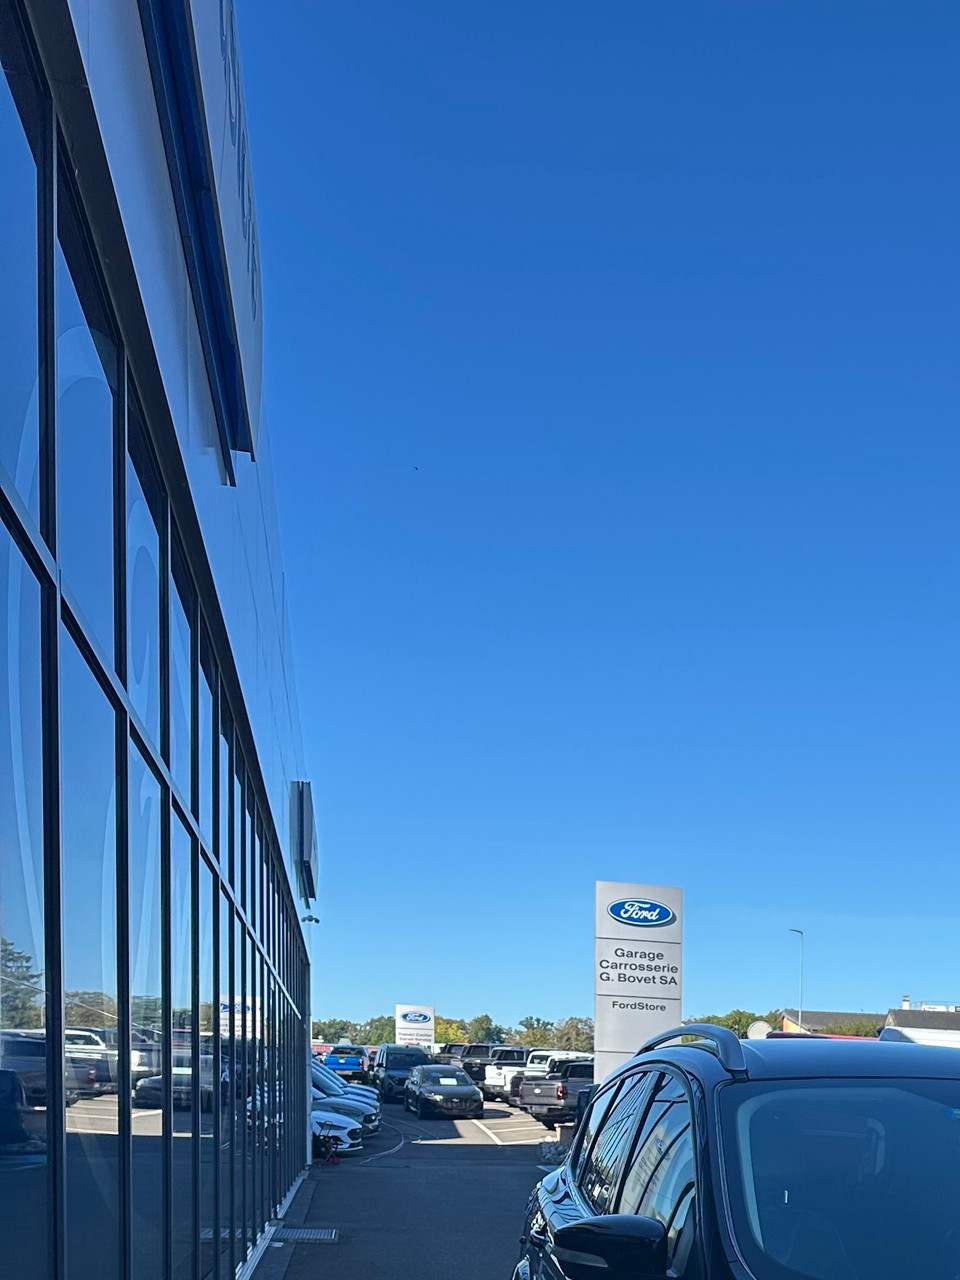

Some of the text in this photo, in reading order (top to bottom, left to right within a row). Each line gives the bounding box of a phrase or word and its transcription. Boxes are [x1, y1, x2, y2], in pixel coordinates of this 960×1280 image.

[621, 902, 660, 920] Ford
[614, 948, 664, 961] Garage
[599, 960, 678, 973] Carrosserie
[599, 972, 678, 986] G. Bovet SA
[612, 1000, 667, 1012] FordStore
